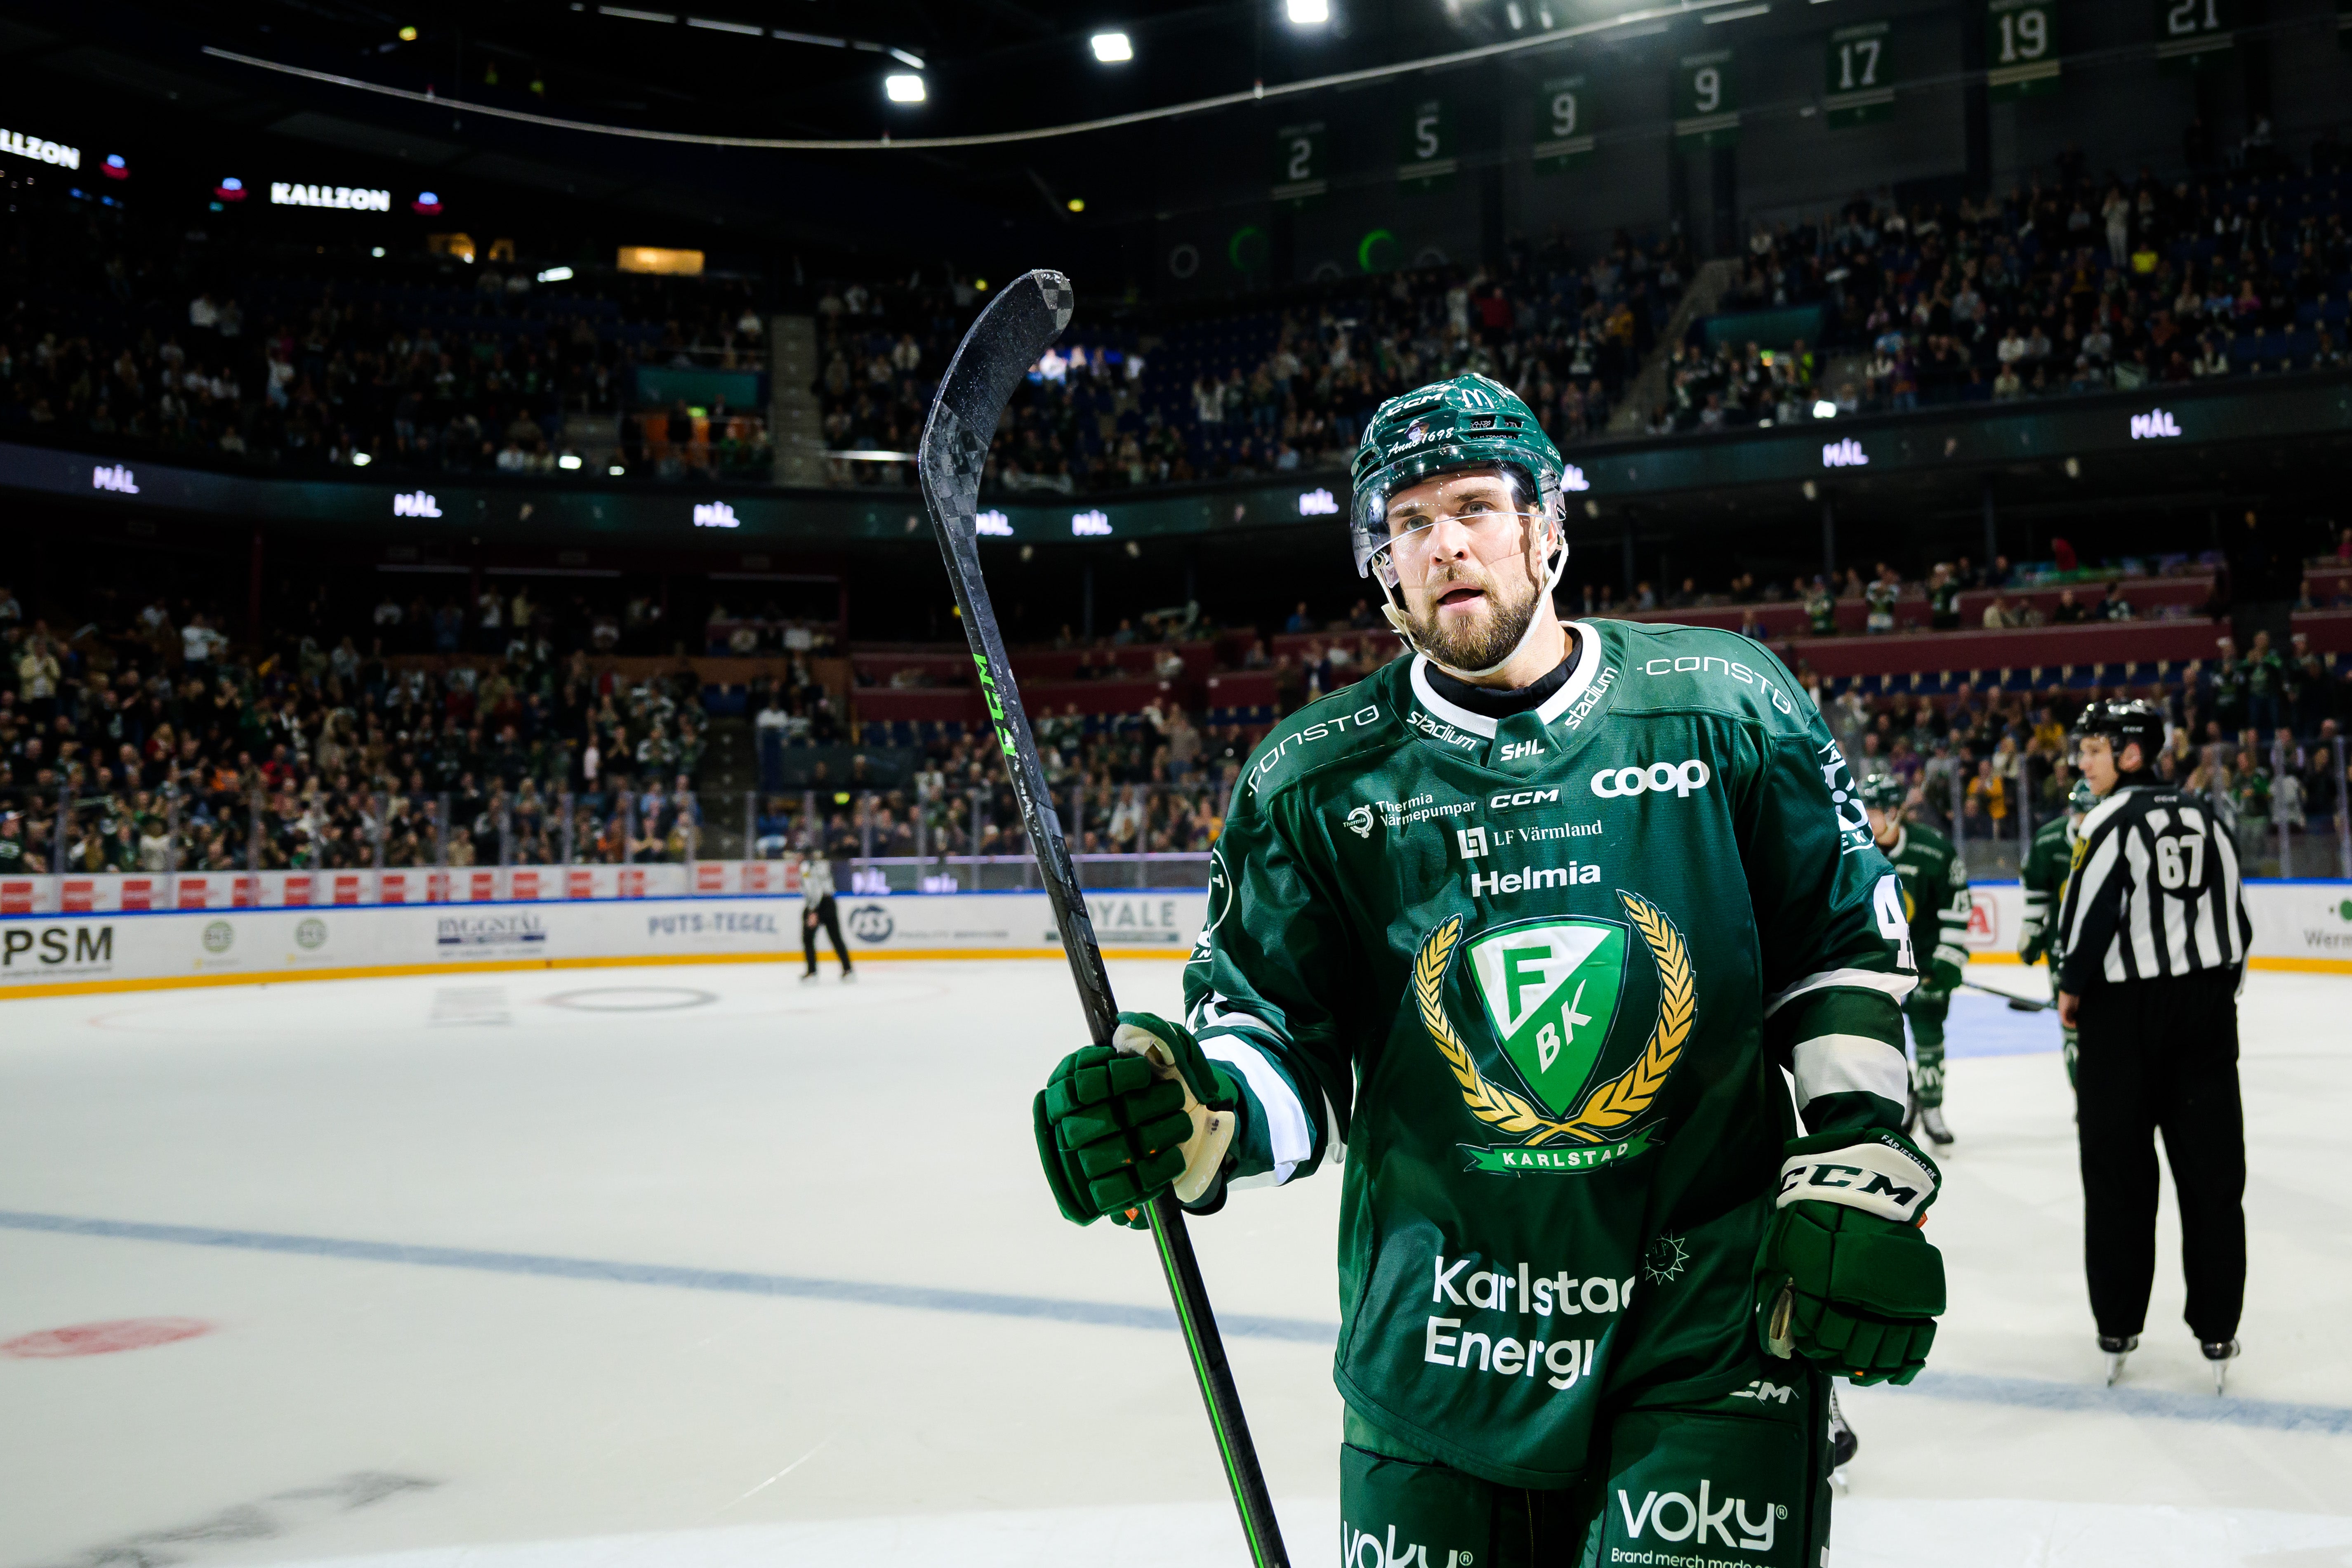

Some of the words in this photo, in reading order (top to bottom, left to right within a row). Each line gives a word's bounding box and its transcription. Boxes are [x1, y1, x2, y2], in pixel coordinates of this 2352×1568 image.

[1998, 9, 2048, 63] 19
[1838, 39, 1882, 90] 17
[1694, 67, 1722, 113] 9
[1551, 93, 1578, 137] 9
[0, 128, 80, 170] LLZON
[1415, 114, 1440, 159] 5
[1288, 138, 1312, 181] 2
[270, 182, 391, 212] KALLZON
[1386, 393, 1444, 416] CCM
[2130, 407, 2182, 440] MÅL
[1387, 440, 1420, 457] Anno
[1421, 427, 1454, 444] 1698
[1822, 436, 1869, 468] MÅL
[93, 464, 140, 494] MÅL
[1560, 464, 1590, 492] ÅL
[394, 490, 443, 518] MÅL
[693, 500, 740, 528] MÅL
[1299, 487, 1339, 516] MÅL
[1072, 509, 1113, 536] MÅL
[973, 653, 1016, 757] CCM
[1564, 666, 1619, 731] stadium
[1406, 710, 1477, 751] stadium
[1500, 738, 1545, 762] SHL
[1590, 759, 1710, 798] coop
[1375, 792, 1433, 813] Thermia
[1380, 801, 1477, 826] Värmepumpar
[1490, 789, 1560, 809] CCM
[1343, 817, 1367, 828] Thermia
[1493, 830, 1514, 846] LF
[1518, 820, 1603, 842] Värmland
[2156, 834, 2204, 890] 67
[1471, 861, 1601, 898] Helmia
[1873, 874, 1918, 972] 4
[2, 926, 113, 965] PSM
[1502, 946, 1552, 1026] F
[1535, 979, 1593, 1075] BK
[1502, 1143, 1629, 1169] KARLSTAD
[1780, 1164, 1919, 1207] CCM
[1925, 1167, 1937, 1180] BK
[1611, 1547, 1652, 1565] Brand
[1655, 1554, 1704, 1568] merch
